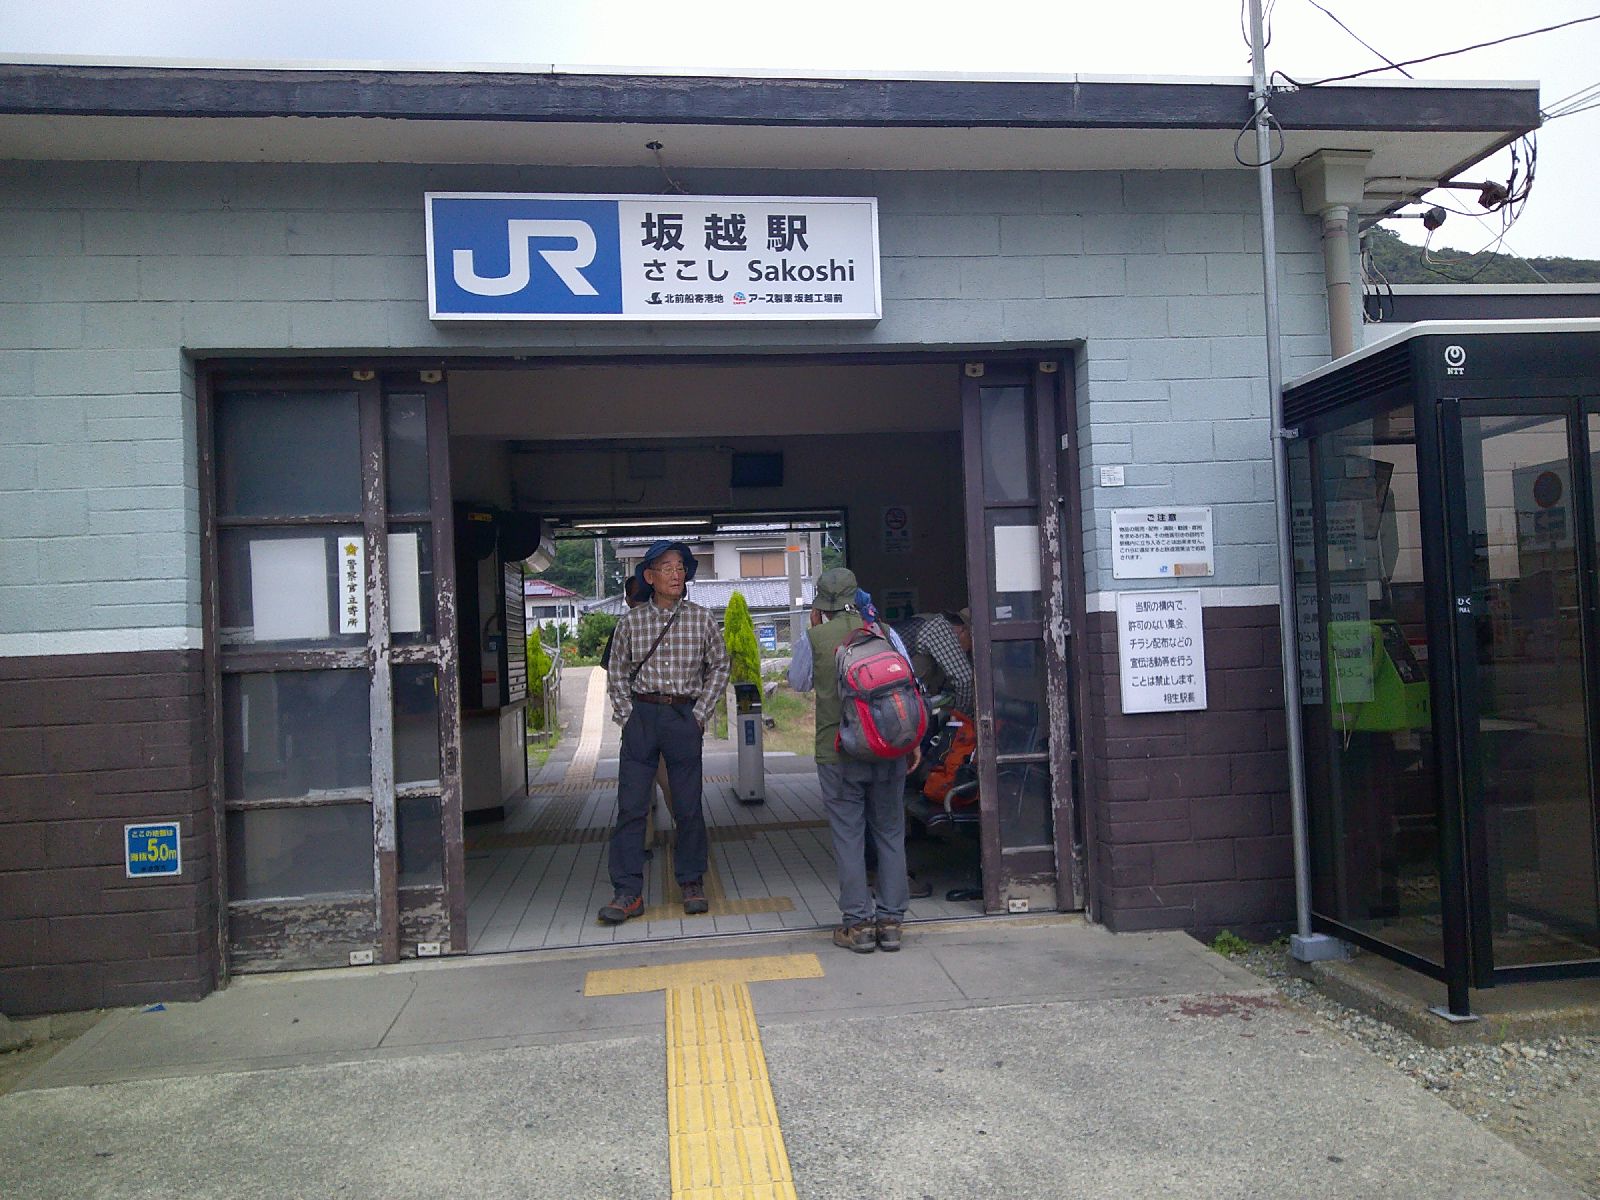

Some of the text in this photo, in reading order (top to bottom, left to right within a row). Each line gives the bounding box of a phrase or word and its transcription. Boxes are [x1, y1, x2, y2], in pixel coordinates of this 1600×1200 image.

[641, 212, 809, 252] 坂越駅
[453, 219, 600, 297] JR
[643, 258, 855, 282] さこし Sakoshi
[664, 293, 724, 304] 北前船寄港地
[1447, 367, 1465, 375] NTT
[1147, 513, 1177, 522] ご注意
[347, 559, 358, 628] 警察官立寄所
[1457, 597, 1471, 606] ひく
[1128, 618, 1188, 632] 許可のない集会、
[1129, 637, 1193, 650] チラシ配布などの
[1131, 674, 1197, 687] ことは禁止します。
